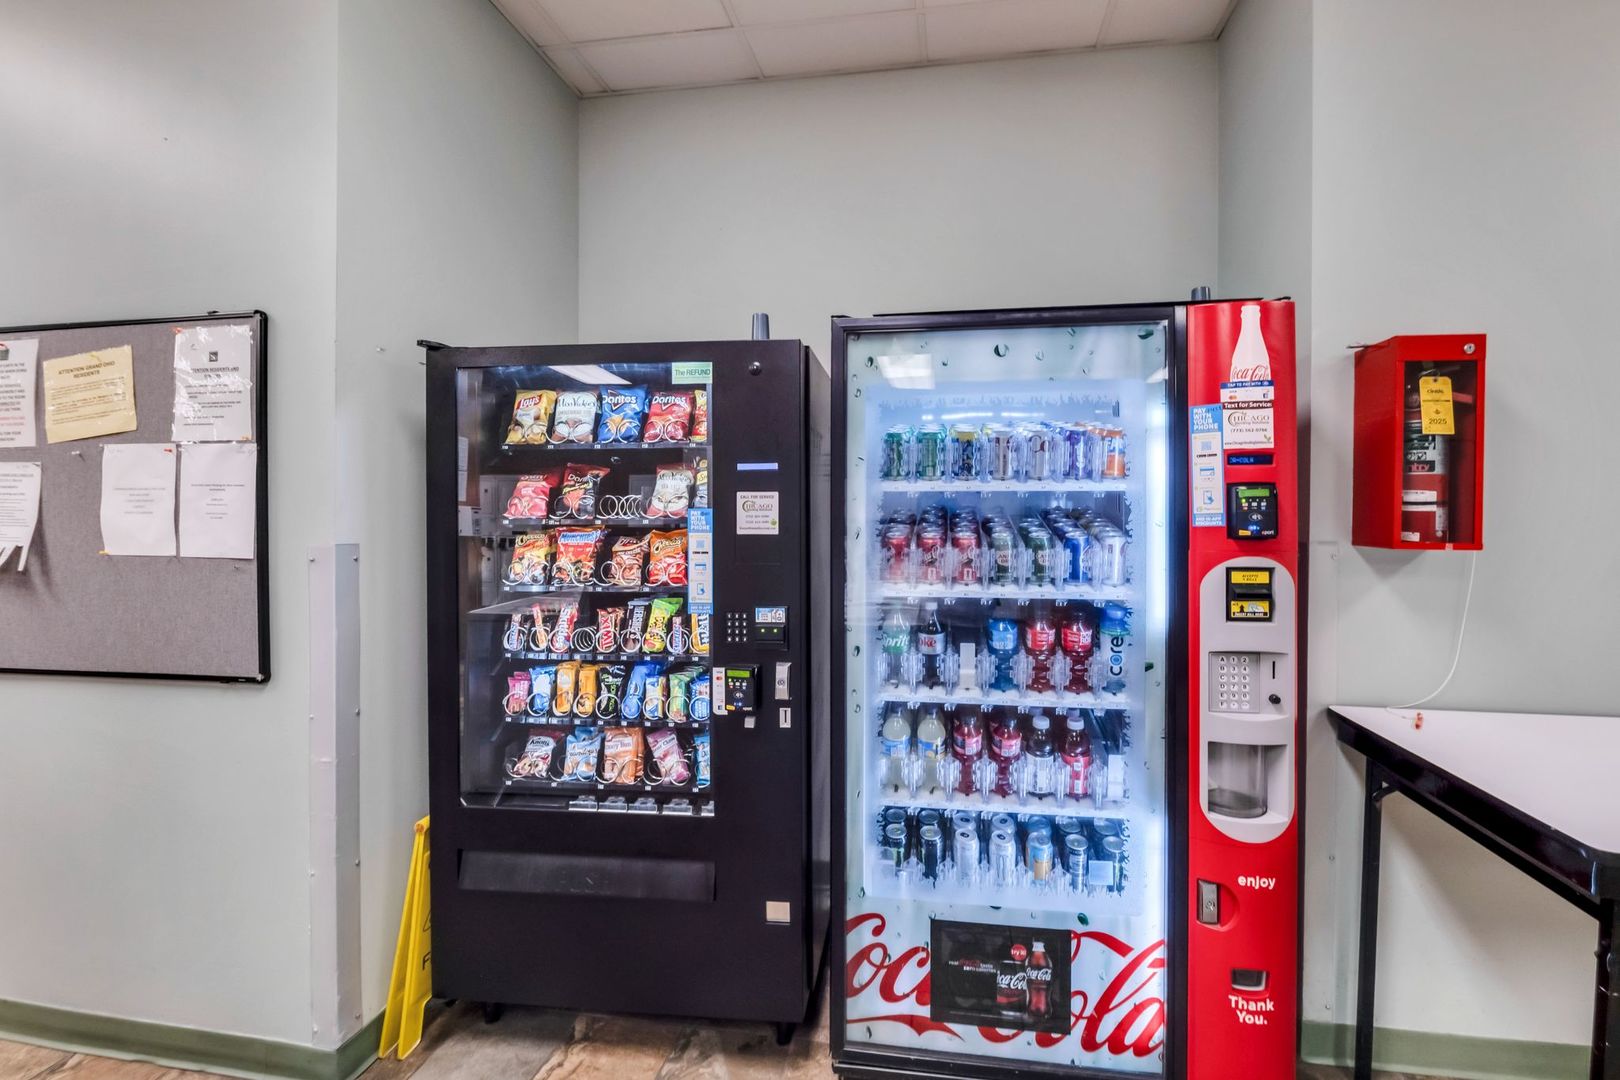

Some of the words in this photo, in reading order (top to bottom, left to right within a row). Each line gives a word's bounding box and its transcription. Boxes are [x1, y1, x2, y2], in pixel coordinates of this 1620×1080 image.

[58, 365, 85, 375] ATTENTION
[73, 369, 100, 379] RESIDENTS
[686, 368, 711, 376] REFUND
[602, 395, 637, 404] Doritos
[652, 395, 686, 404] Doritos
[1428, 417, 1448, 425] 2025
[1194, 423, 1219, 431] PHONE
[599, 616, 615, 650] TWIX
[1110, 636, 1124, 676] core
[1237, 875, 1276, 890] enjoy
[1228, 994, 1275, 1012] Thank
[1236, 1009, 1268, 1025] You.
